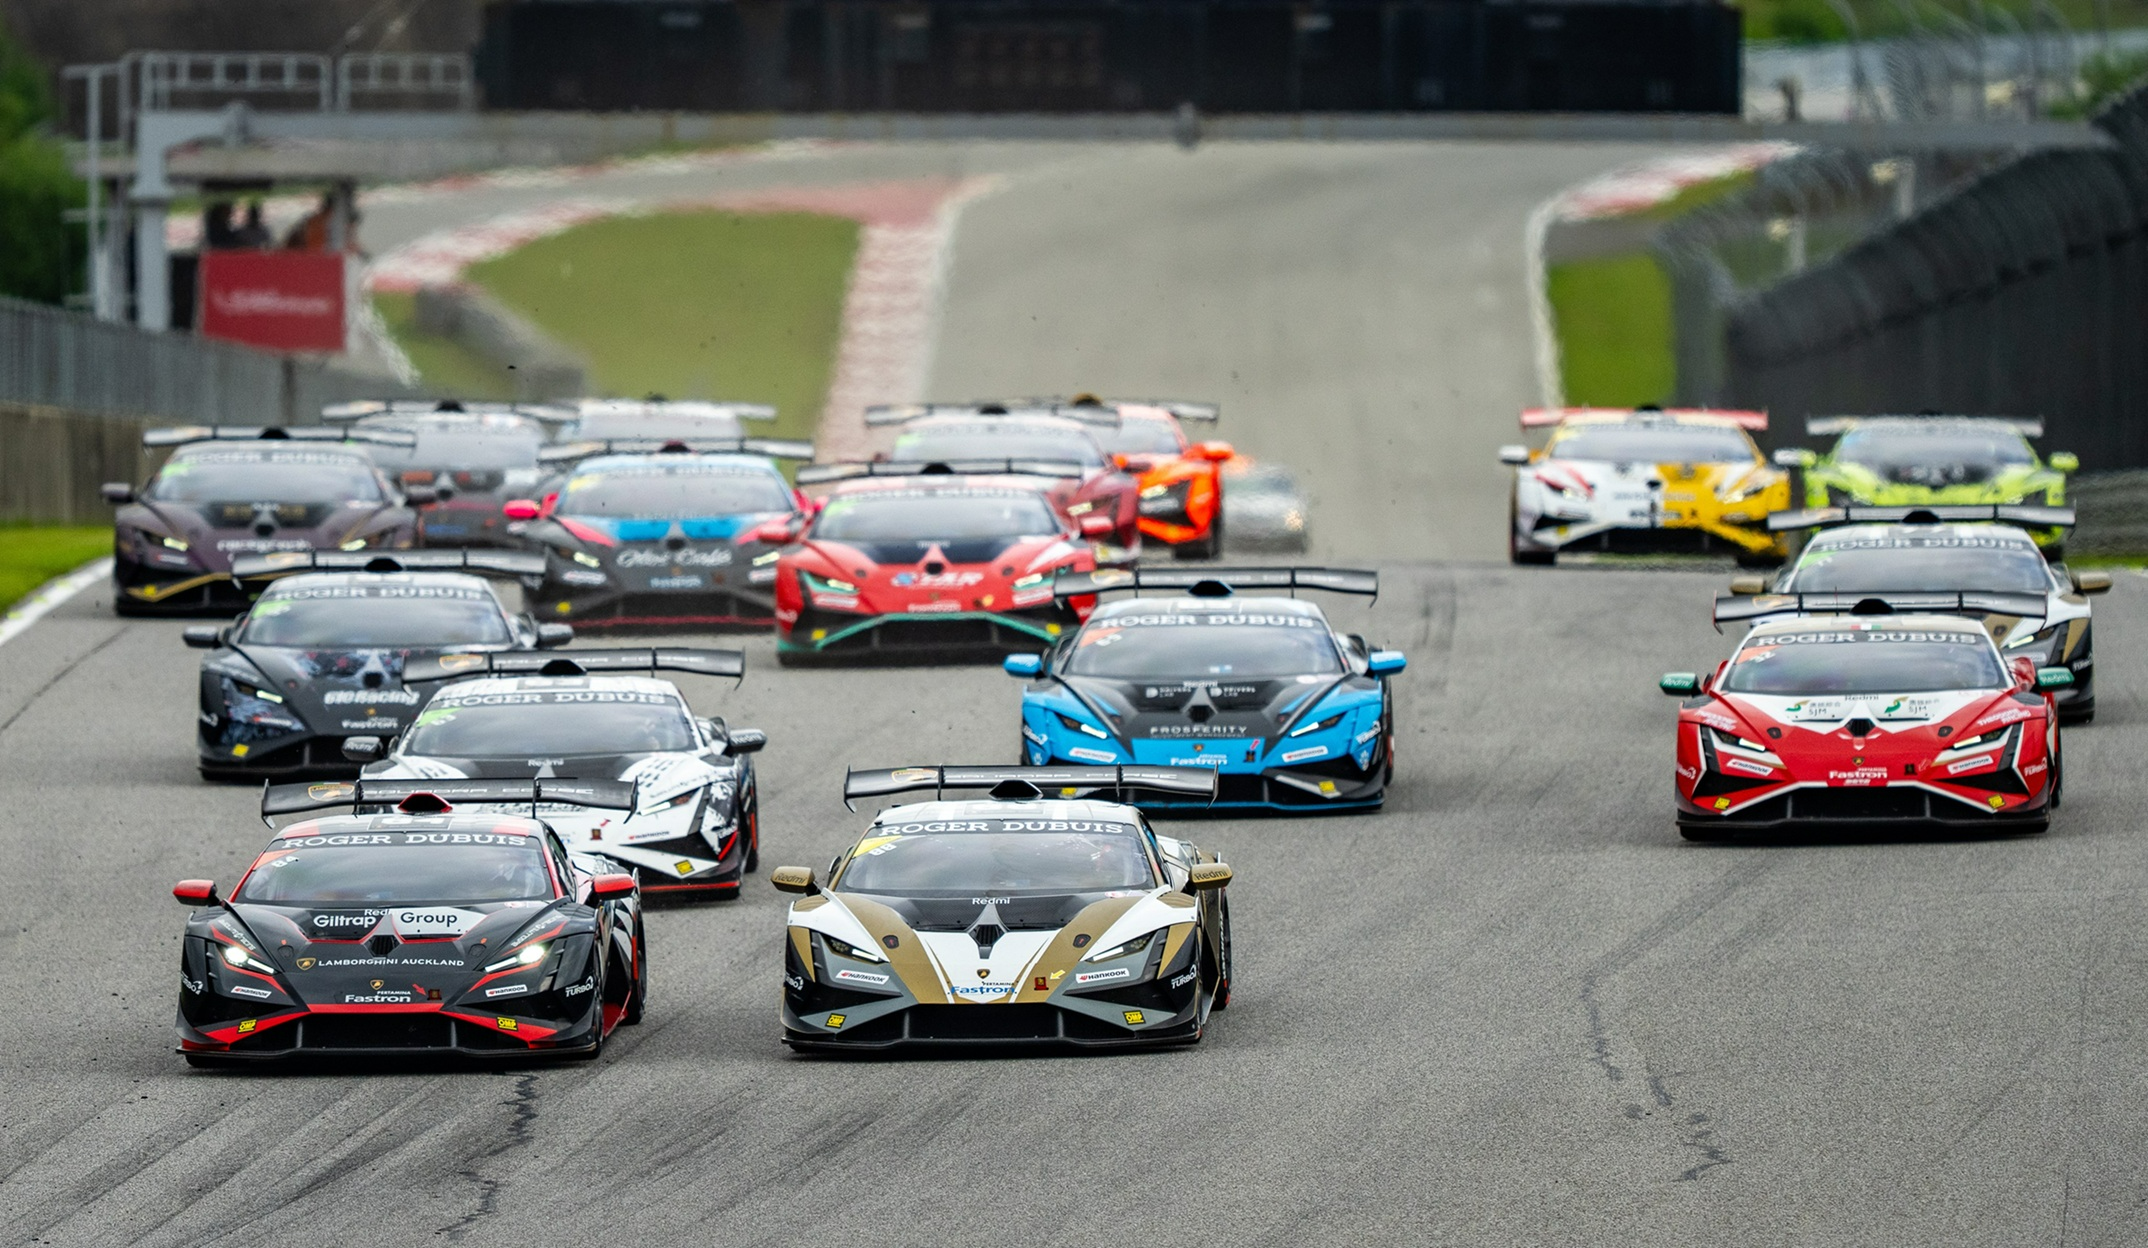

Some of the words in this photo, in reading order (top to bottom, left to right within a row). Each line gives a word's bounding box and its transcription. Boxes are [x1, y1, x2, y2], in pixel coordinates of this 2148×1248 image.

[1101, 615, 1196, 628] ROGER
[1207, 614, 1314, 627] DUBUIS
[1756, 633, 1856, 646] ROGER
[1867, 632, 1977, 644] DUBUIS
[442, 694, 543, 708] ROGER
[555, 692, 666, 704] DUBUIS
[878, 822, 989, 836] ROGER
[1002, 821, 1123, 834] DUBUIS
[282, 834, 392, 849] ROGER
[405, 833, 527, 846] DUBUIS
[868, 843, 897, 856] 88
[270, 856, 300, 868] 84
[774, 873, 807, 885] Redmi
[1194, 870, 1228, 880] Redmi
[313, 914, 377, 928] Giltrap
[400, 912, 458, 928] Group
[401, 958, 465, 967] AUCKLAND
[848, 972, 886, 983] HANKOOK
[1088, 970, 1126, 980] HANKOOK
[494, 986, 526, 994] HANKOOK
[950, 986, 1016, 994] Fastron
[344, 994, 412, 1003] Fastron
[498, 1018, 516, 1028] OMP
[828, 1016, 844, 1025] OMP
[1126, 1014, 1142, 1022] OMP
[239, 1021, 256, 1031] OMP
